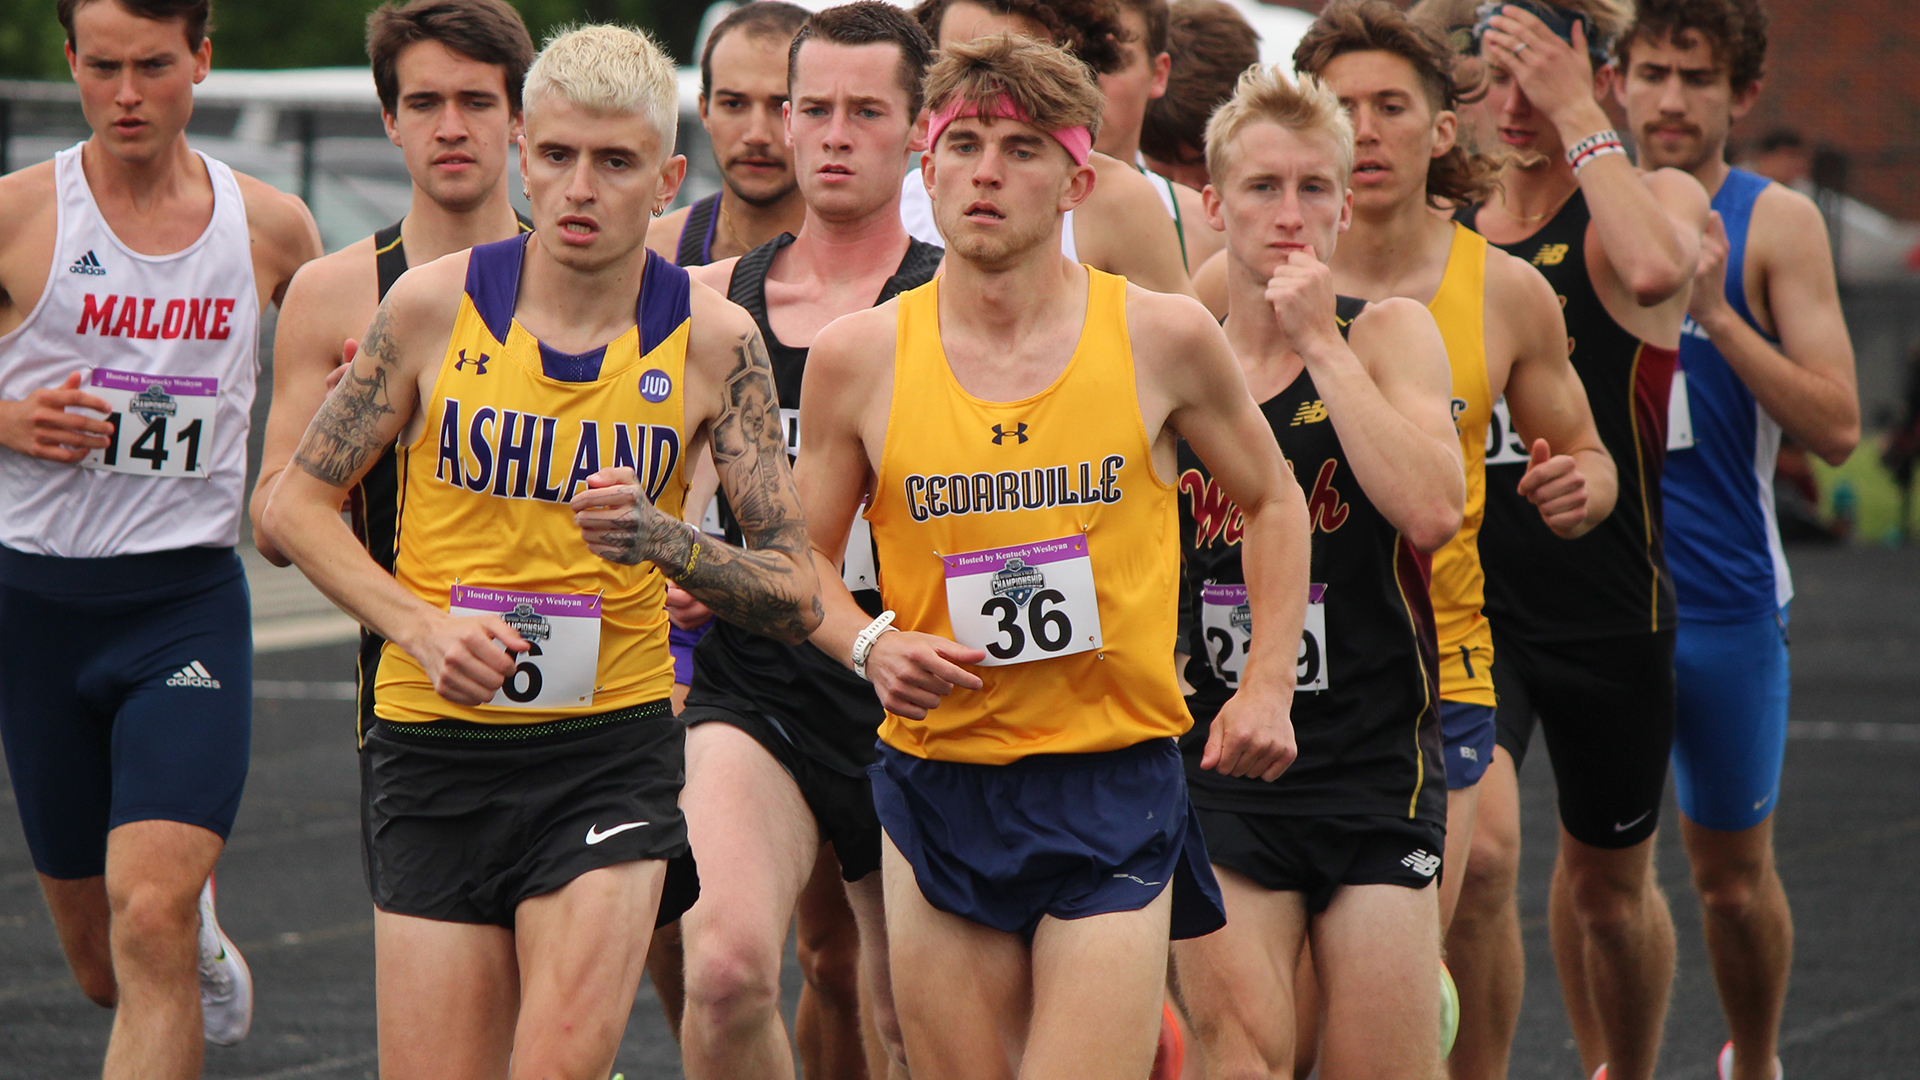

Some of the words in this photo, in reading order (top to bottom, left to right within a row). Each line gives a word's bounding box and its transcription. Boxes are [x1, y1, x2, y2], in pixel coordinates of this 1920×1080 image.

[69, 264, 106, 276] adidas
[76, 293, 236, 340] MALONE
[105, 371, 130, 382] Hosted
[130, 376, 139, 385] by
[641, 375, 670, 397] JUD
[102, 411, 203, 472] 141
[434, 396, 681, 507] ASHLAND
[904, 454, 1126, 523] CEDARVILLE
[959, 555, 984, 566] Hosted
[984, 554, 994, 563] by
[995, 548, 1032, 561] Kentucky
[1032, 542, 1068, 555] Wesleyan
[992, 574, 1043, 591] CHAMPIONSHIP
[467, 589, 494, 601] Hosted
[494, 592, 504, 603] by
[506, 594, 544, 606] Kentucky
[545, 596, 582, 608] Wesleyan
[981, 589, 1073, 660] 36
[165, 675, 222, 690] adidas
[501, 639, 544, 703] 6
